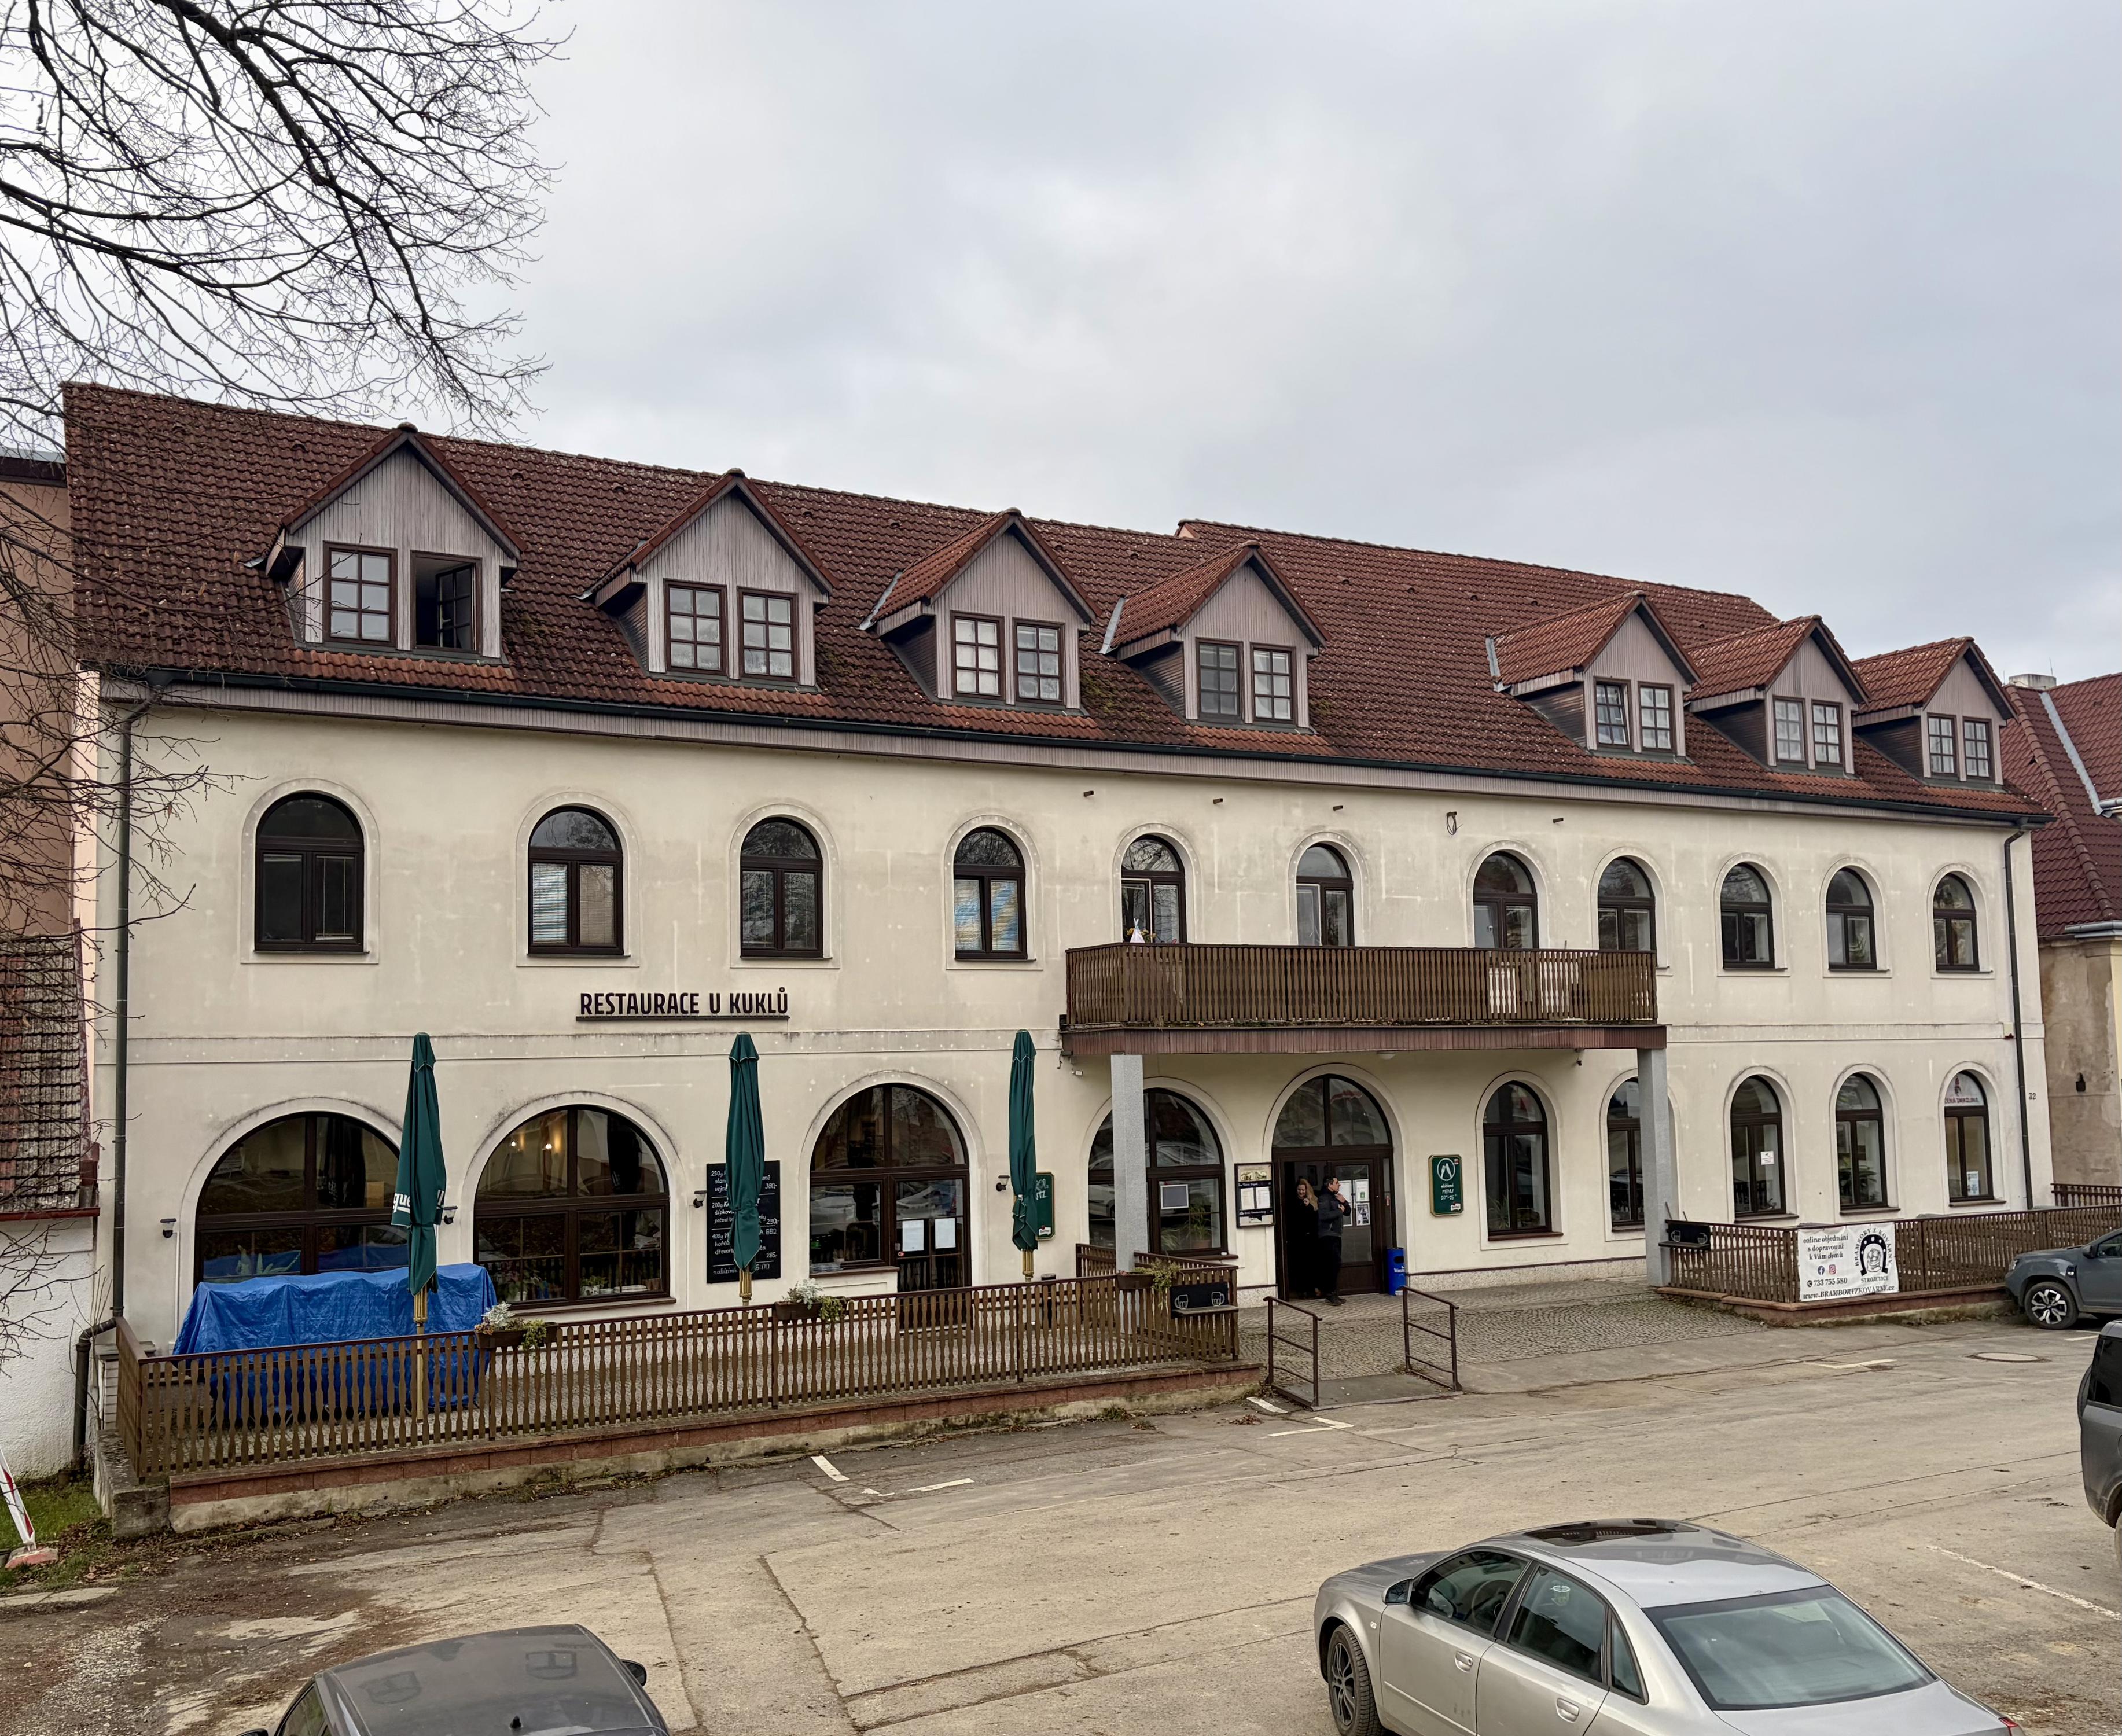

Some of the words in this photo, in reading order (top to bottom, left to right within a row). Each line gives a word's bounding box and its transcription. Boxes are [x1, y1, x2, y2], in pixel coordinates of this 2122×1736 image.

[580, 992, 700, 1015] RESTAURACE
[709, 992, 720, 1014] U
[730, 987, 788, 1014] KUKLŮ
[2028, 1092, 2036, 1100] 32
[1812, 1245, 1838, 1253] dopravou
[1828, 1251, 1843, 1259] domů
